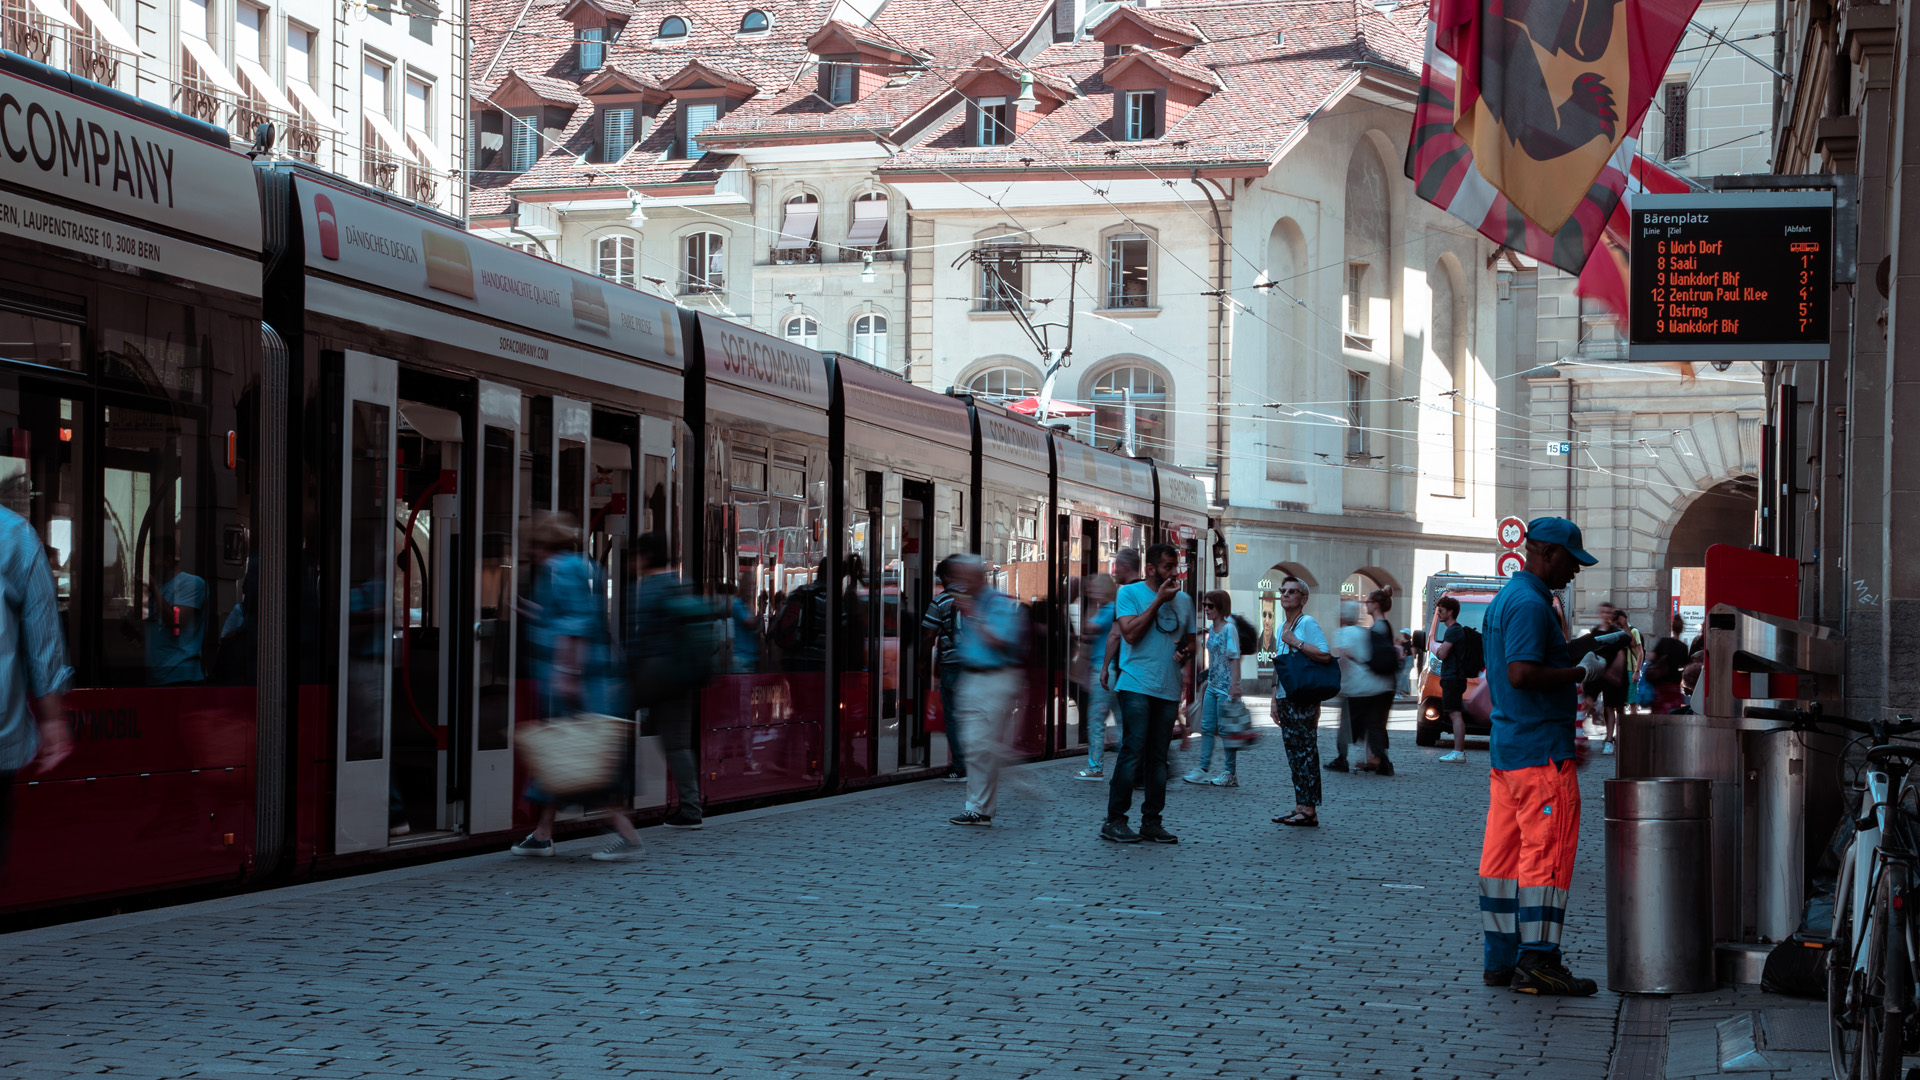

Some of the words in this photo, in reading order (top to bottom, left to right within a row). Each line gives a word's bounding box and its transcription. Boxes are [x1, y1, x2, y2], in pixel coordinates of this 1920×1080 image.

[0, 92, 174, 208] COMPANY
[1644, 212, 1709, 226] Bärenplatz
[23, 211, 99, 246] LAUPENSTRASSE
[102, 232, 114, 252] 10,
[116, 234, 136, 255] 3008
[138, 240, 160, 262] BERN
[1787, 225, 1811, 233] Abfahrt
[345, 225, 390, 256] DÄNISCHES
[391, 240, 418, 264] DESIGN
[1658, 241, 1665, 254] 6
[1670, 241, 1696, 254] Worb
[1699, 240, 1723, 255] Dorf
[1658, 257, 1665, 270] 8
[1670, 256, 1697, 270] Saali
[1657, 272, 1665, 285] 9
[1670, 272, 1719, 287] Wankdorf
[1722, 271, 1741, 286] Bhf
[482, 270, 532, 300] HANDGEMACHTE
[533, 286, 561, 308] QUALITÄT
[1651, 288, 1665, 301] 12
[1670, 288, 1714, 301] Zentrum
[1716, 288, 1740, 300] Paul
[1744, 287, 1768, 300] Klee
[1657, 304, 1665, 317] 7
[1669, 304, 1708, 318] Ostring
[1657, 320, 1665, 333] 9
[1669, 320, 1719, 334] Wankdorf
[1721, 319, 1740, 334] Bhf
[499, 336, 549, 361] SOFACOMPANY.COM
[720, 330, 812, 394] SOFACOMPANY
[1549, 444, 1558, 453] 15
[65, 708, 142, 742] RNMOBIL
